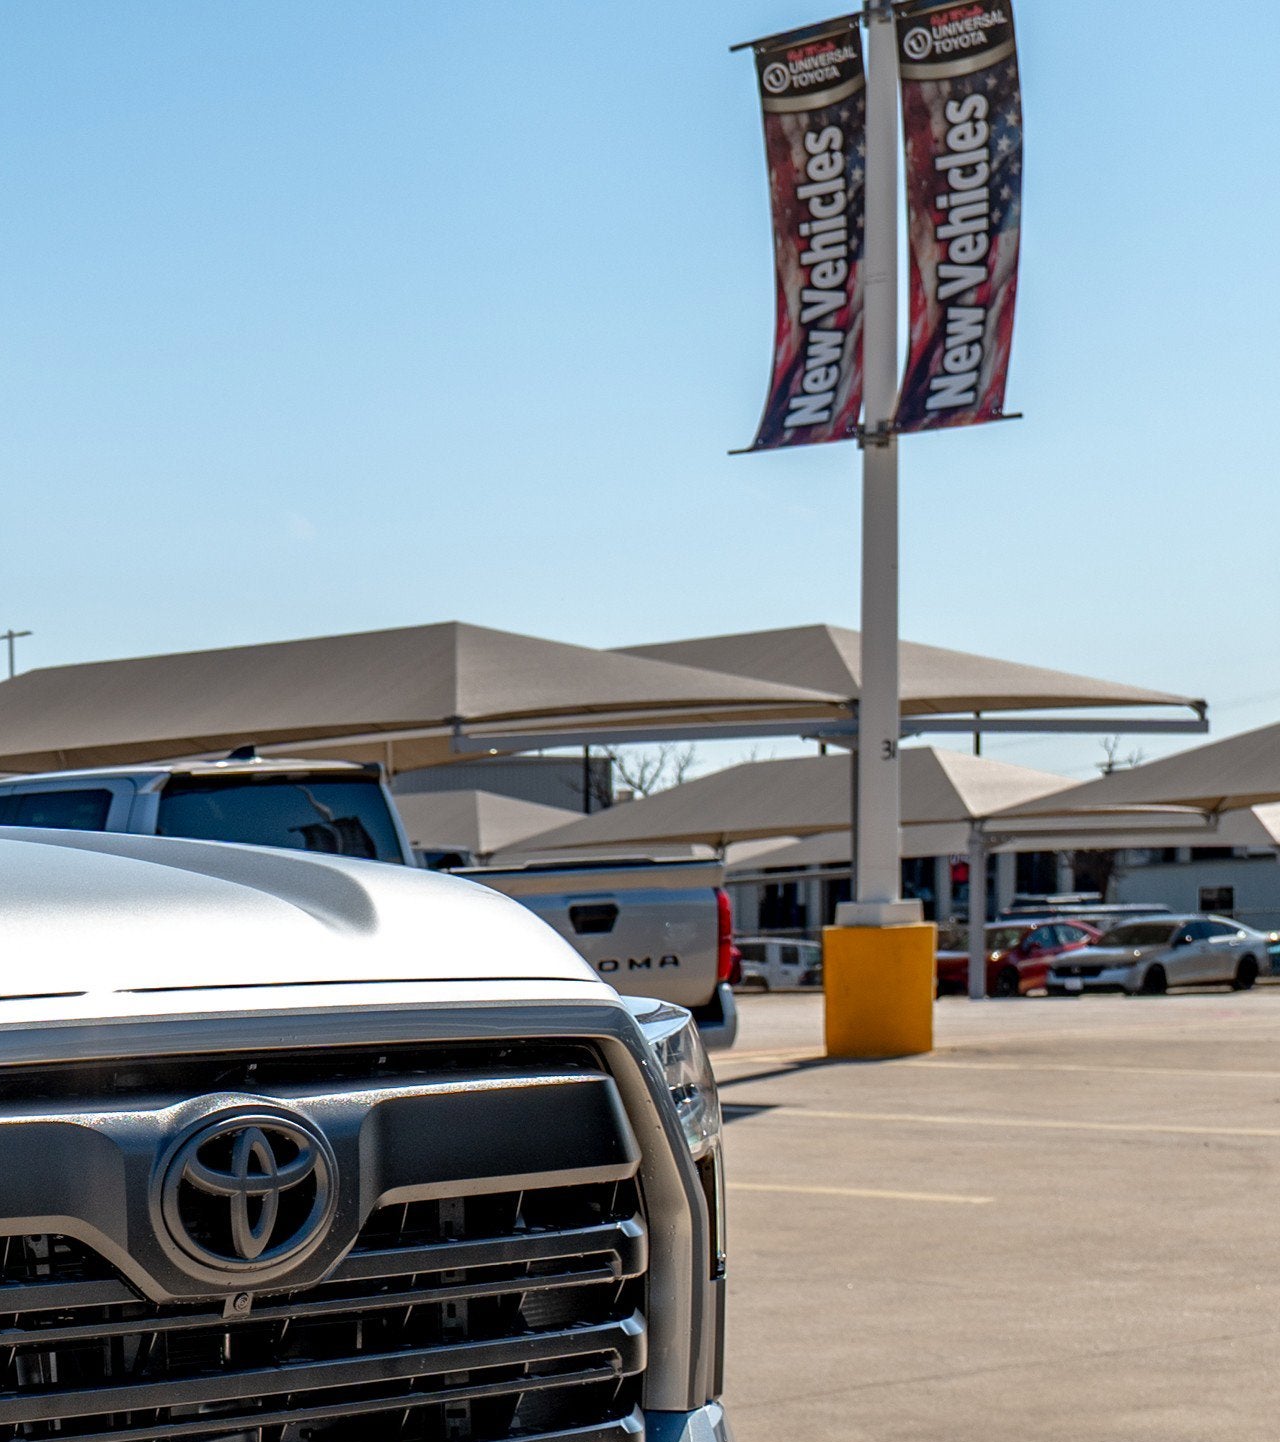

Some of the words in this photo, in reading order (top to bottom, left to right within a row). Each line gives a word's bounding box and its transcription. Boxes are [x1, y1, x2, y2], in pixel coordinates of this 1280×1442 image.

[931, 9, 1008, 40] UNIVERSAL
[933, 29, 988, 55] TOYOTA
[788, 45, 858, 74] UNIVERSAL
[791, 64, 841, 88] TOYOTA
[796, 124, 849, 325] Vehicles
[934, 93, 990, 301] Vehicles
[782, 330, 845, 429] New
[925, 306, 985, 411] New
